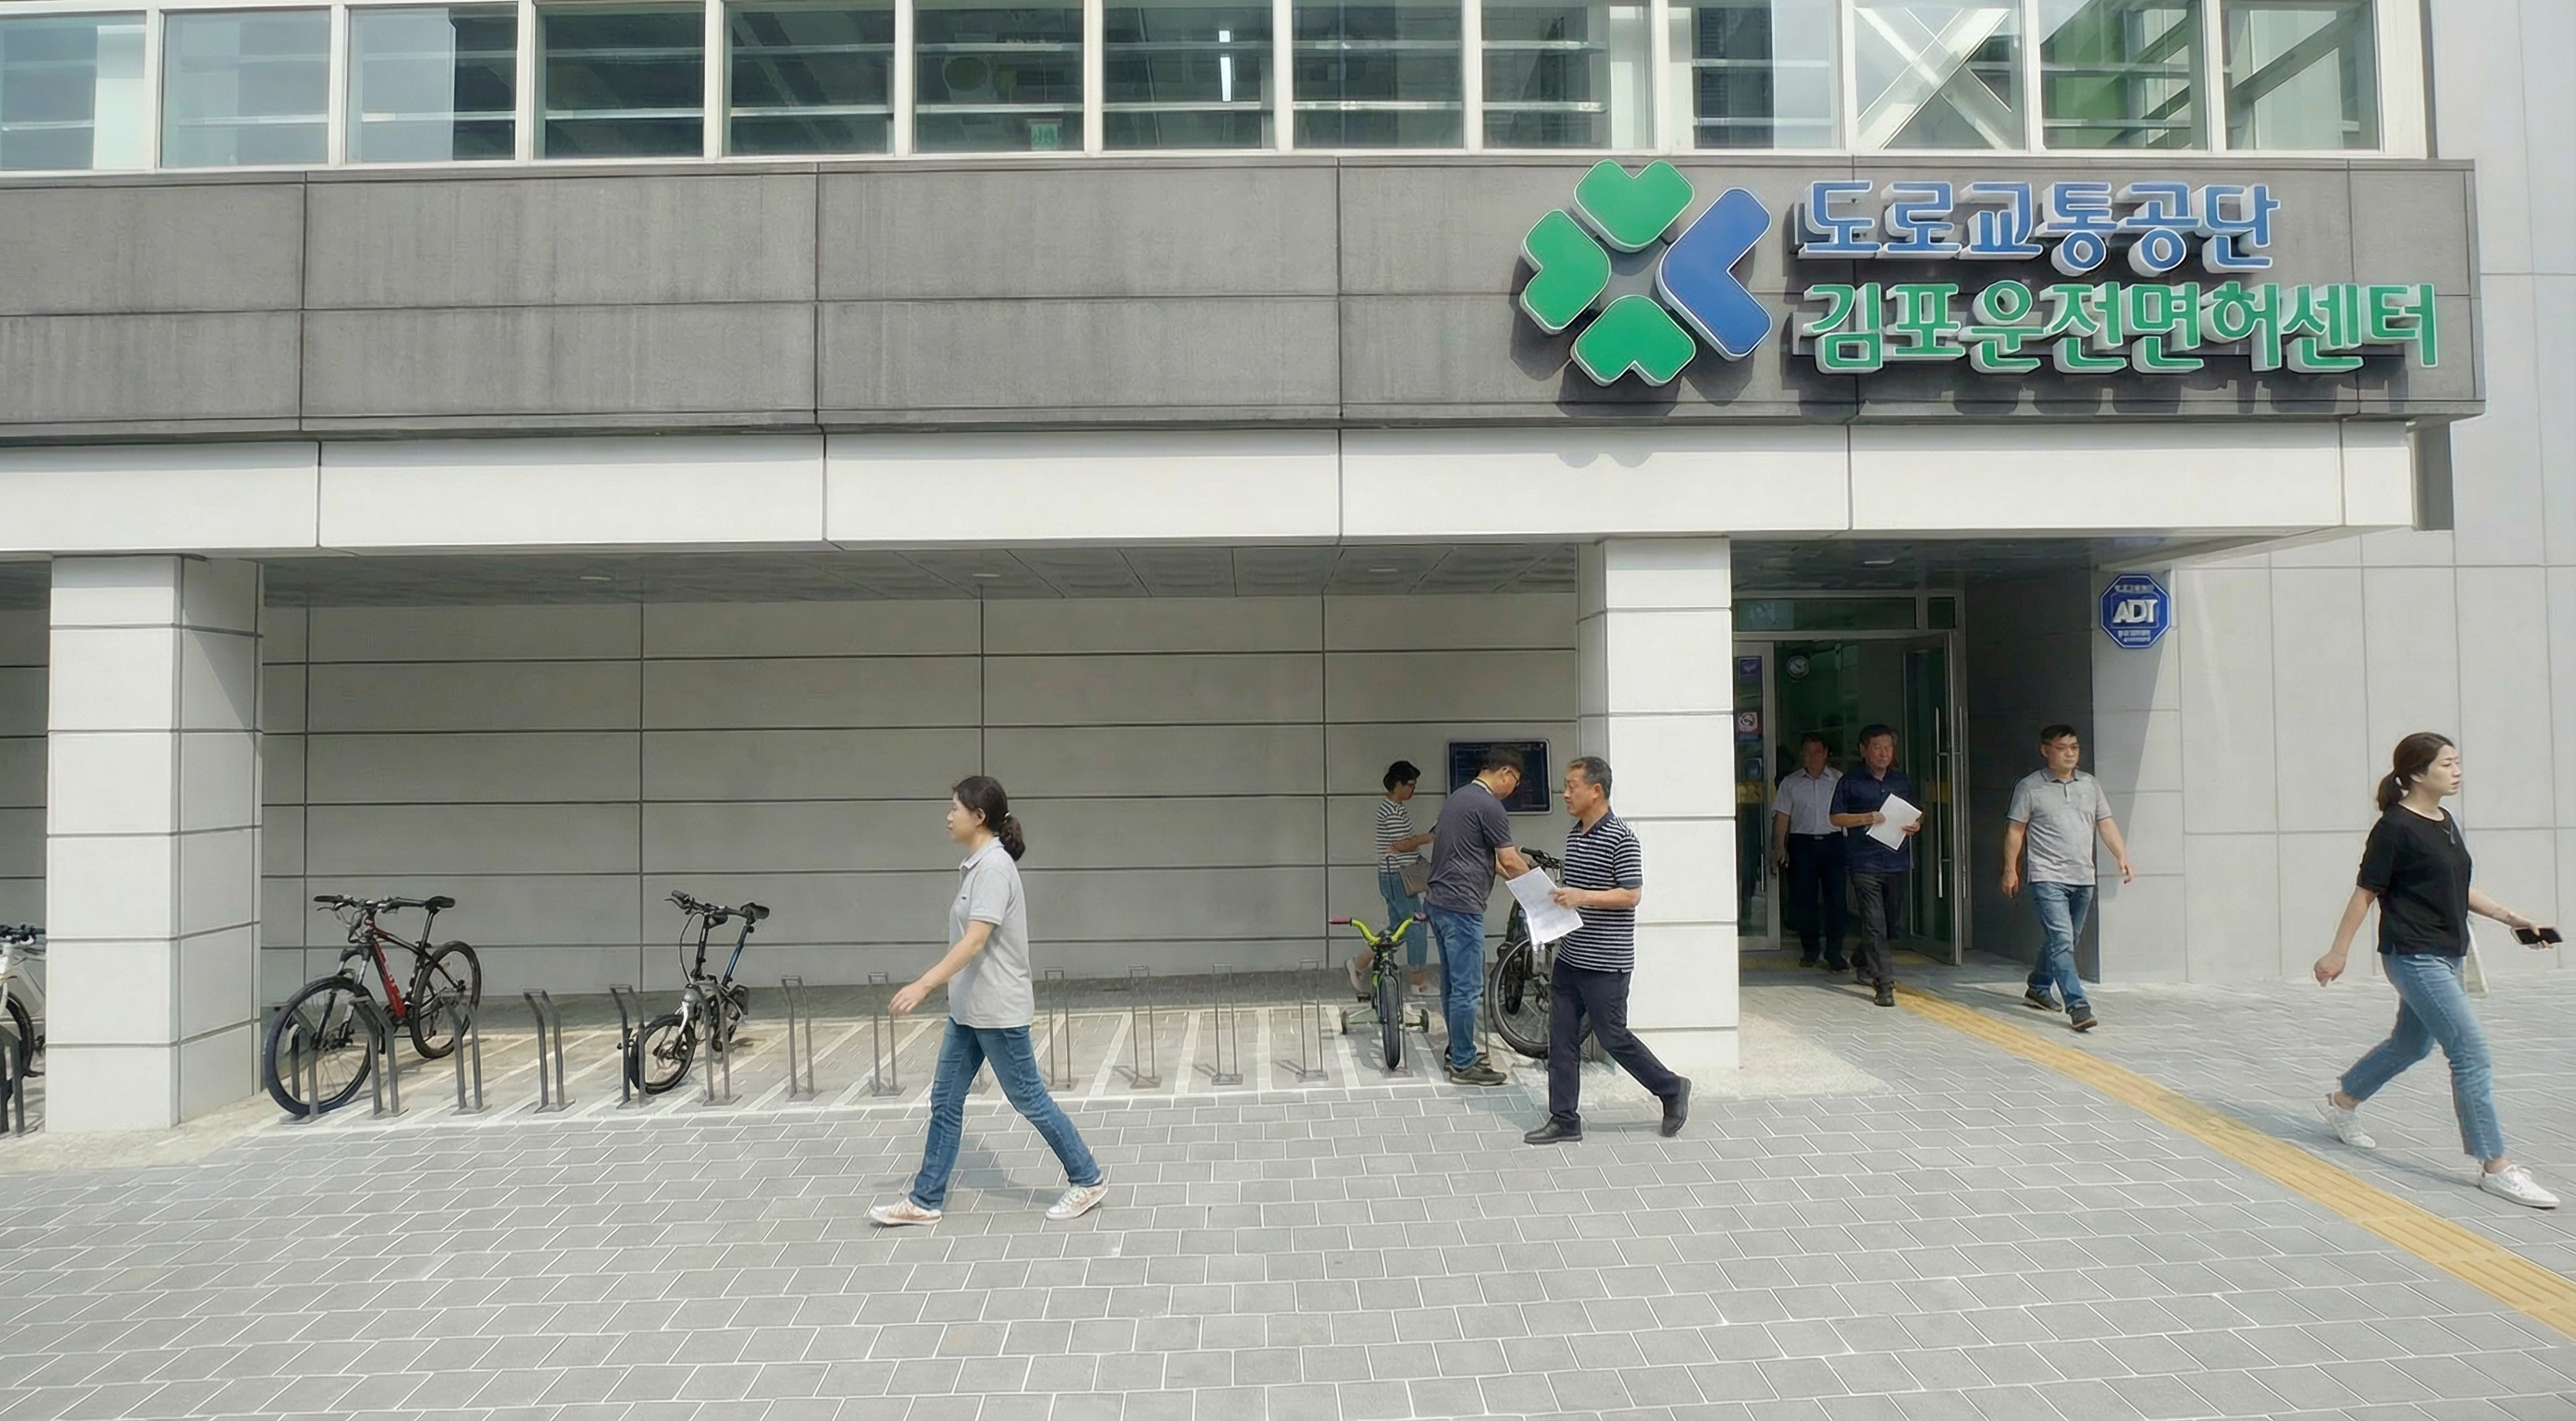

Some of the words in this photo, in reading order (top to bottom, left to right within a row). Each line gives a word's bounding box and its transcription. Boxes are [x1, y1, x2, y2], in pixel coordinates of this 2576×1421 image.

[1799, 180, 2281, 275] 도로교통공단
[1802, 281, 2438, 374] 김포운전면허센터
[2112, 599, 2158, 624] ADT
